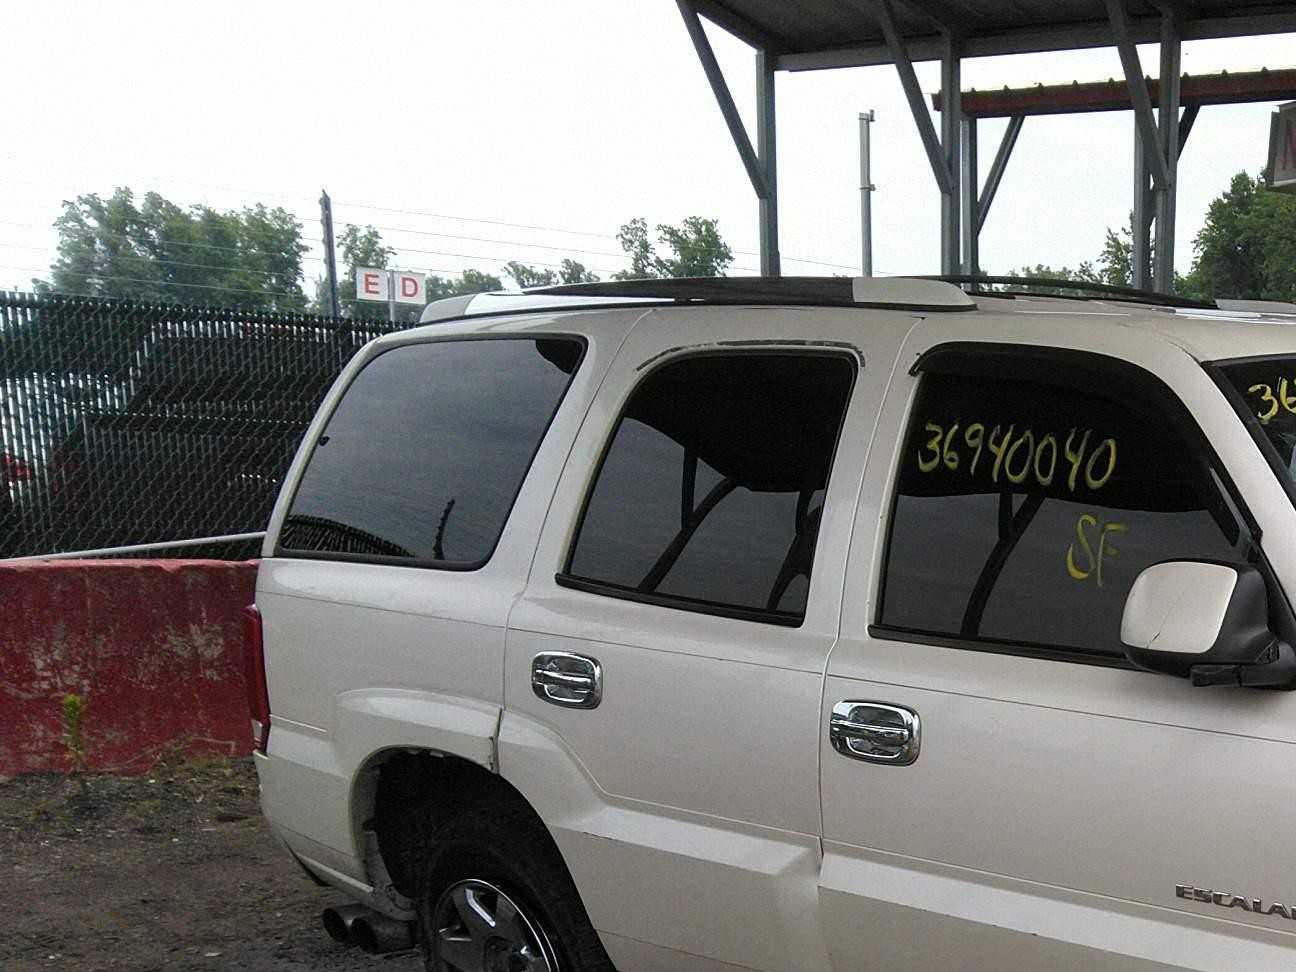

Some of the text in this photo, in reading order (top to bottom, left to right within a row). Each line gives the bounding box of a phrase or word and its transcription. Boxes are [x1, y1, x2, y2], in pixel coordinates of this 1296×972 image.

[364, 273, 380, 295] E
[401, 276, 418, 297] D
[917, 420, 1117, 492] 36940040
[1066, 513, 1130, 588] SF
